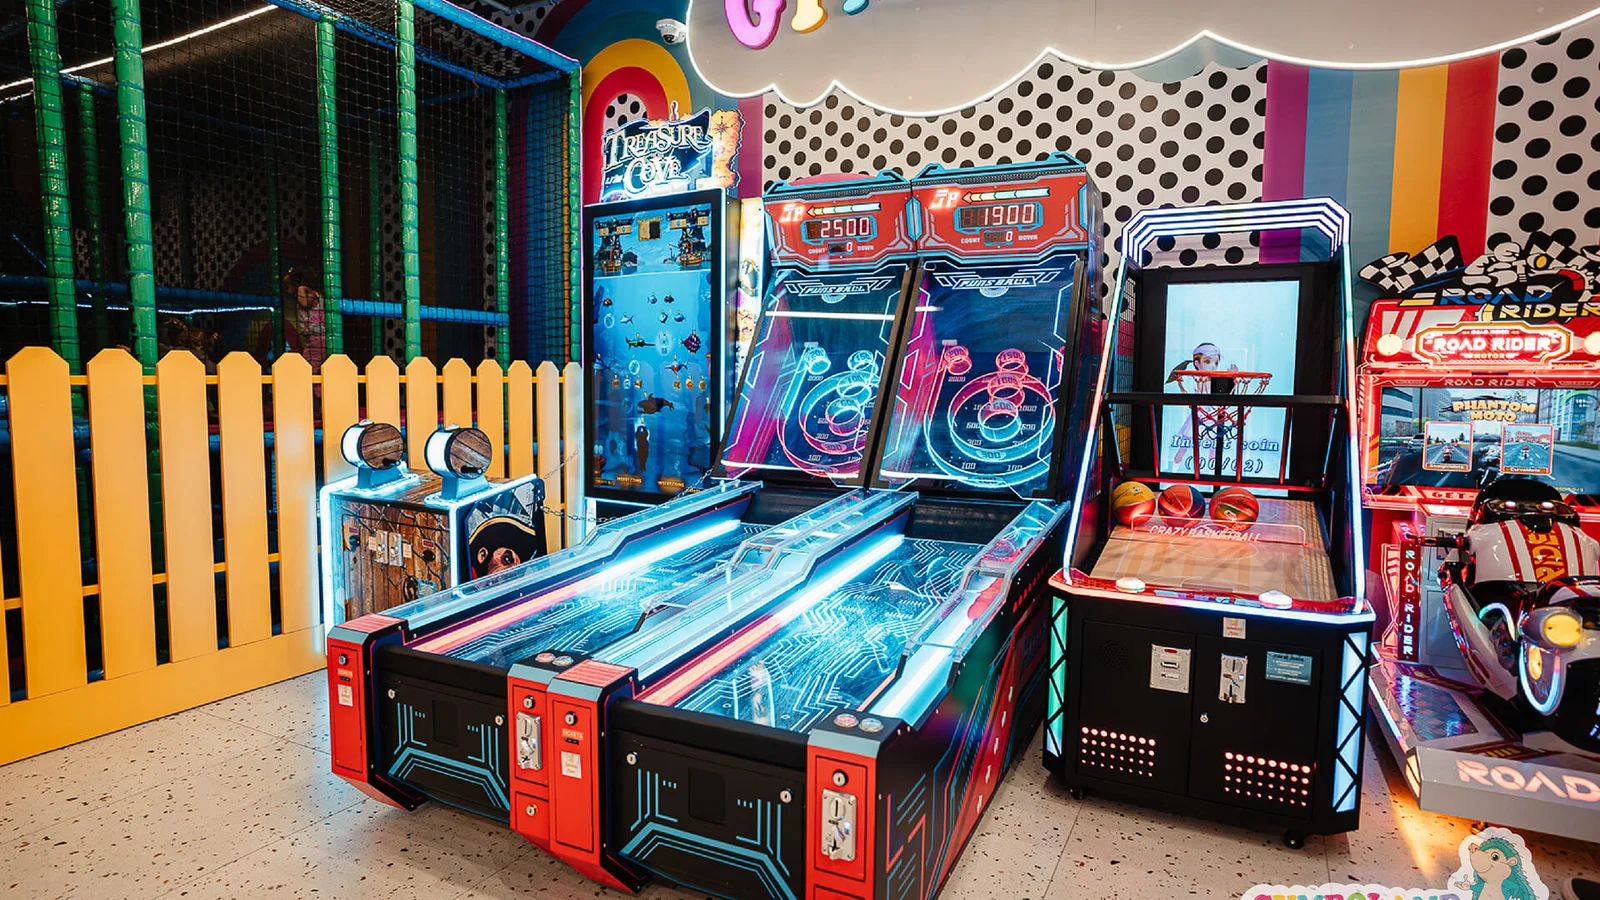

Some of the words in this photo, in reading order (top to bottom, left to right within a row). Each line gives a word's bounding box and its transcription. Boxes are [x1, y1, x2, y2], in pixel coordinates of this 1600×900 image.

[605, 125, 705, 169] TREASURE
[624, 155, 689, 194] COVE
[984, 204, 1035, 225] 1900
[821, 217, 869, 237] 2500
[1005, 231, 1013, 241] 0
[846, 242, 853, 252] 0
[1440, 285, 1552, 305] ROAD
[1500, 302, 1600, 318] RIDER
[1433, 337, 1487, 351] ROAD
[1491, 337, 1551, 351] RIDER
[1452, 400, 1537, 414] PHANTOM
[1470, 411, 1517, 422] MOTO
[1170, 435, 1231, 449] Inet
[961, 462, 976, 470] 100
[1403, 603, 1414, 656] RIDER
[1456, 760, 1600, 802] ROAD
